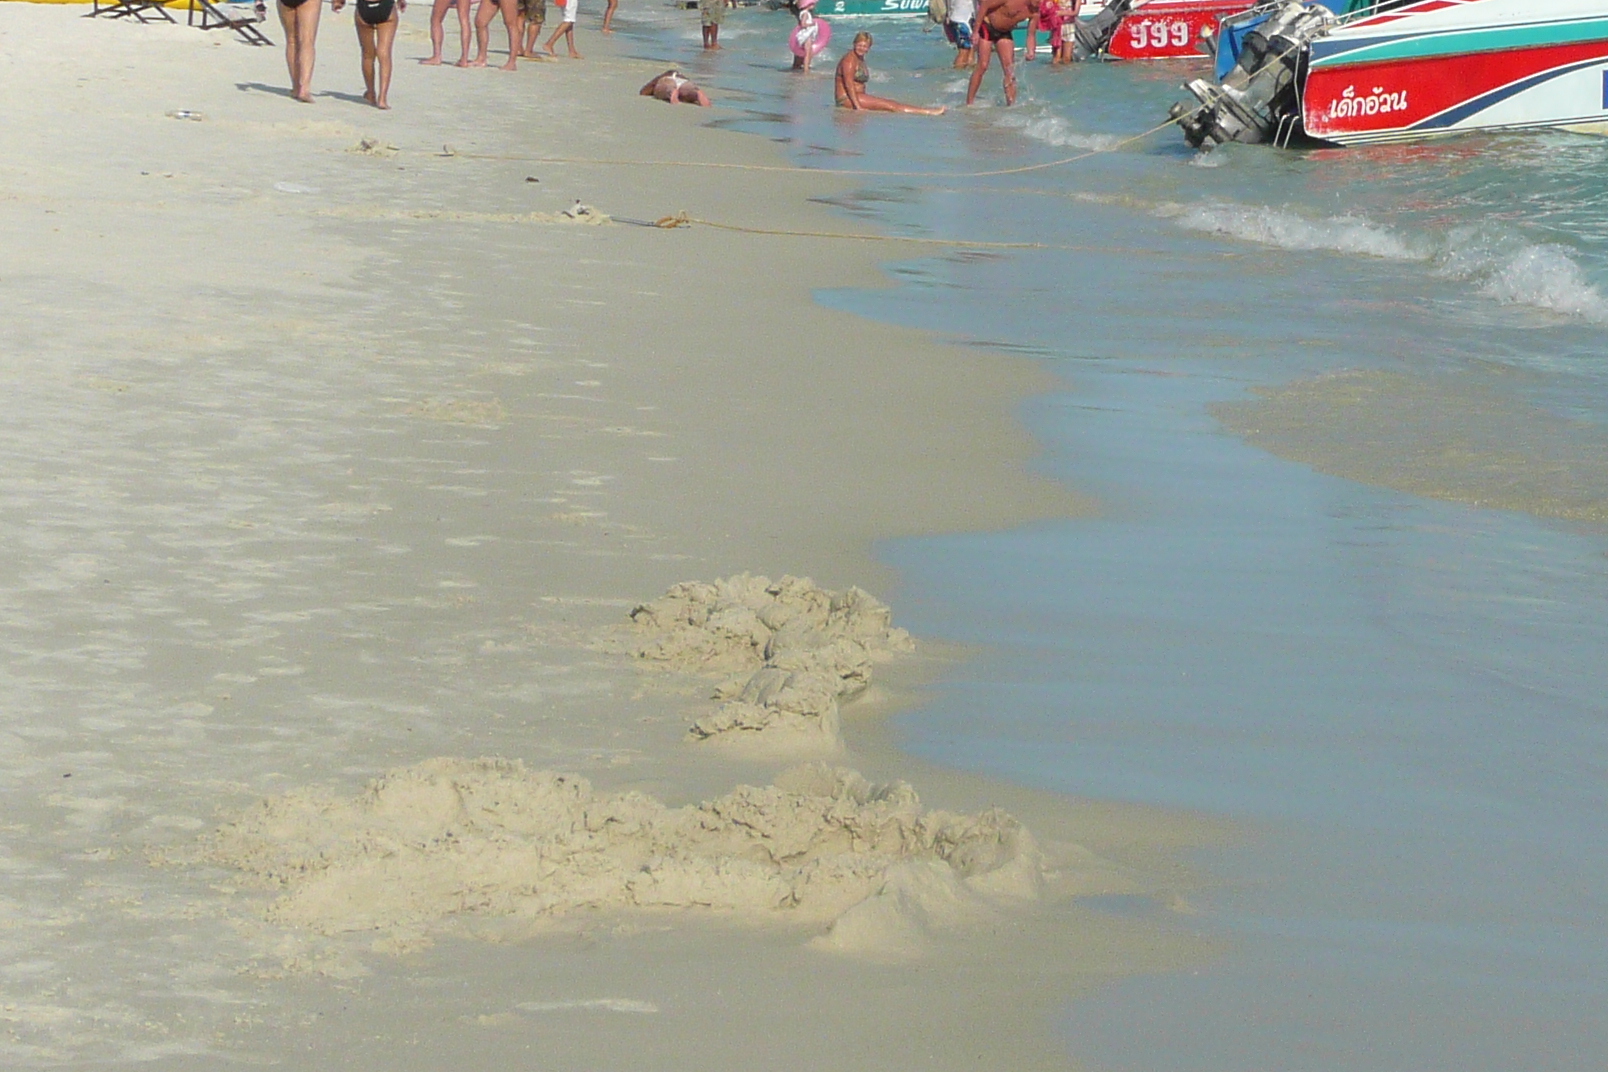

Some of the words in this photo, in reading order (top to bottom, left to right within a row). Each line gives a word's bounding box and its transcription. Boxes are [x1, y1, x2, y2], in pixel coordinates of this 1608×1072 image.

[1130, 20, 1189, 48] 999
[1330, 85, 1407, 118] เด็กอ้วน
